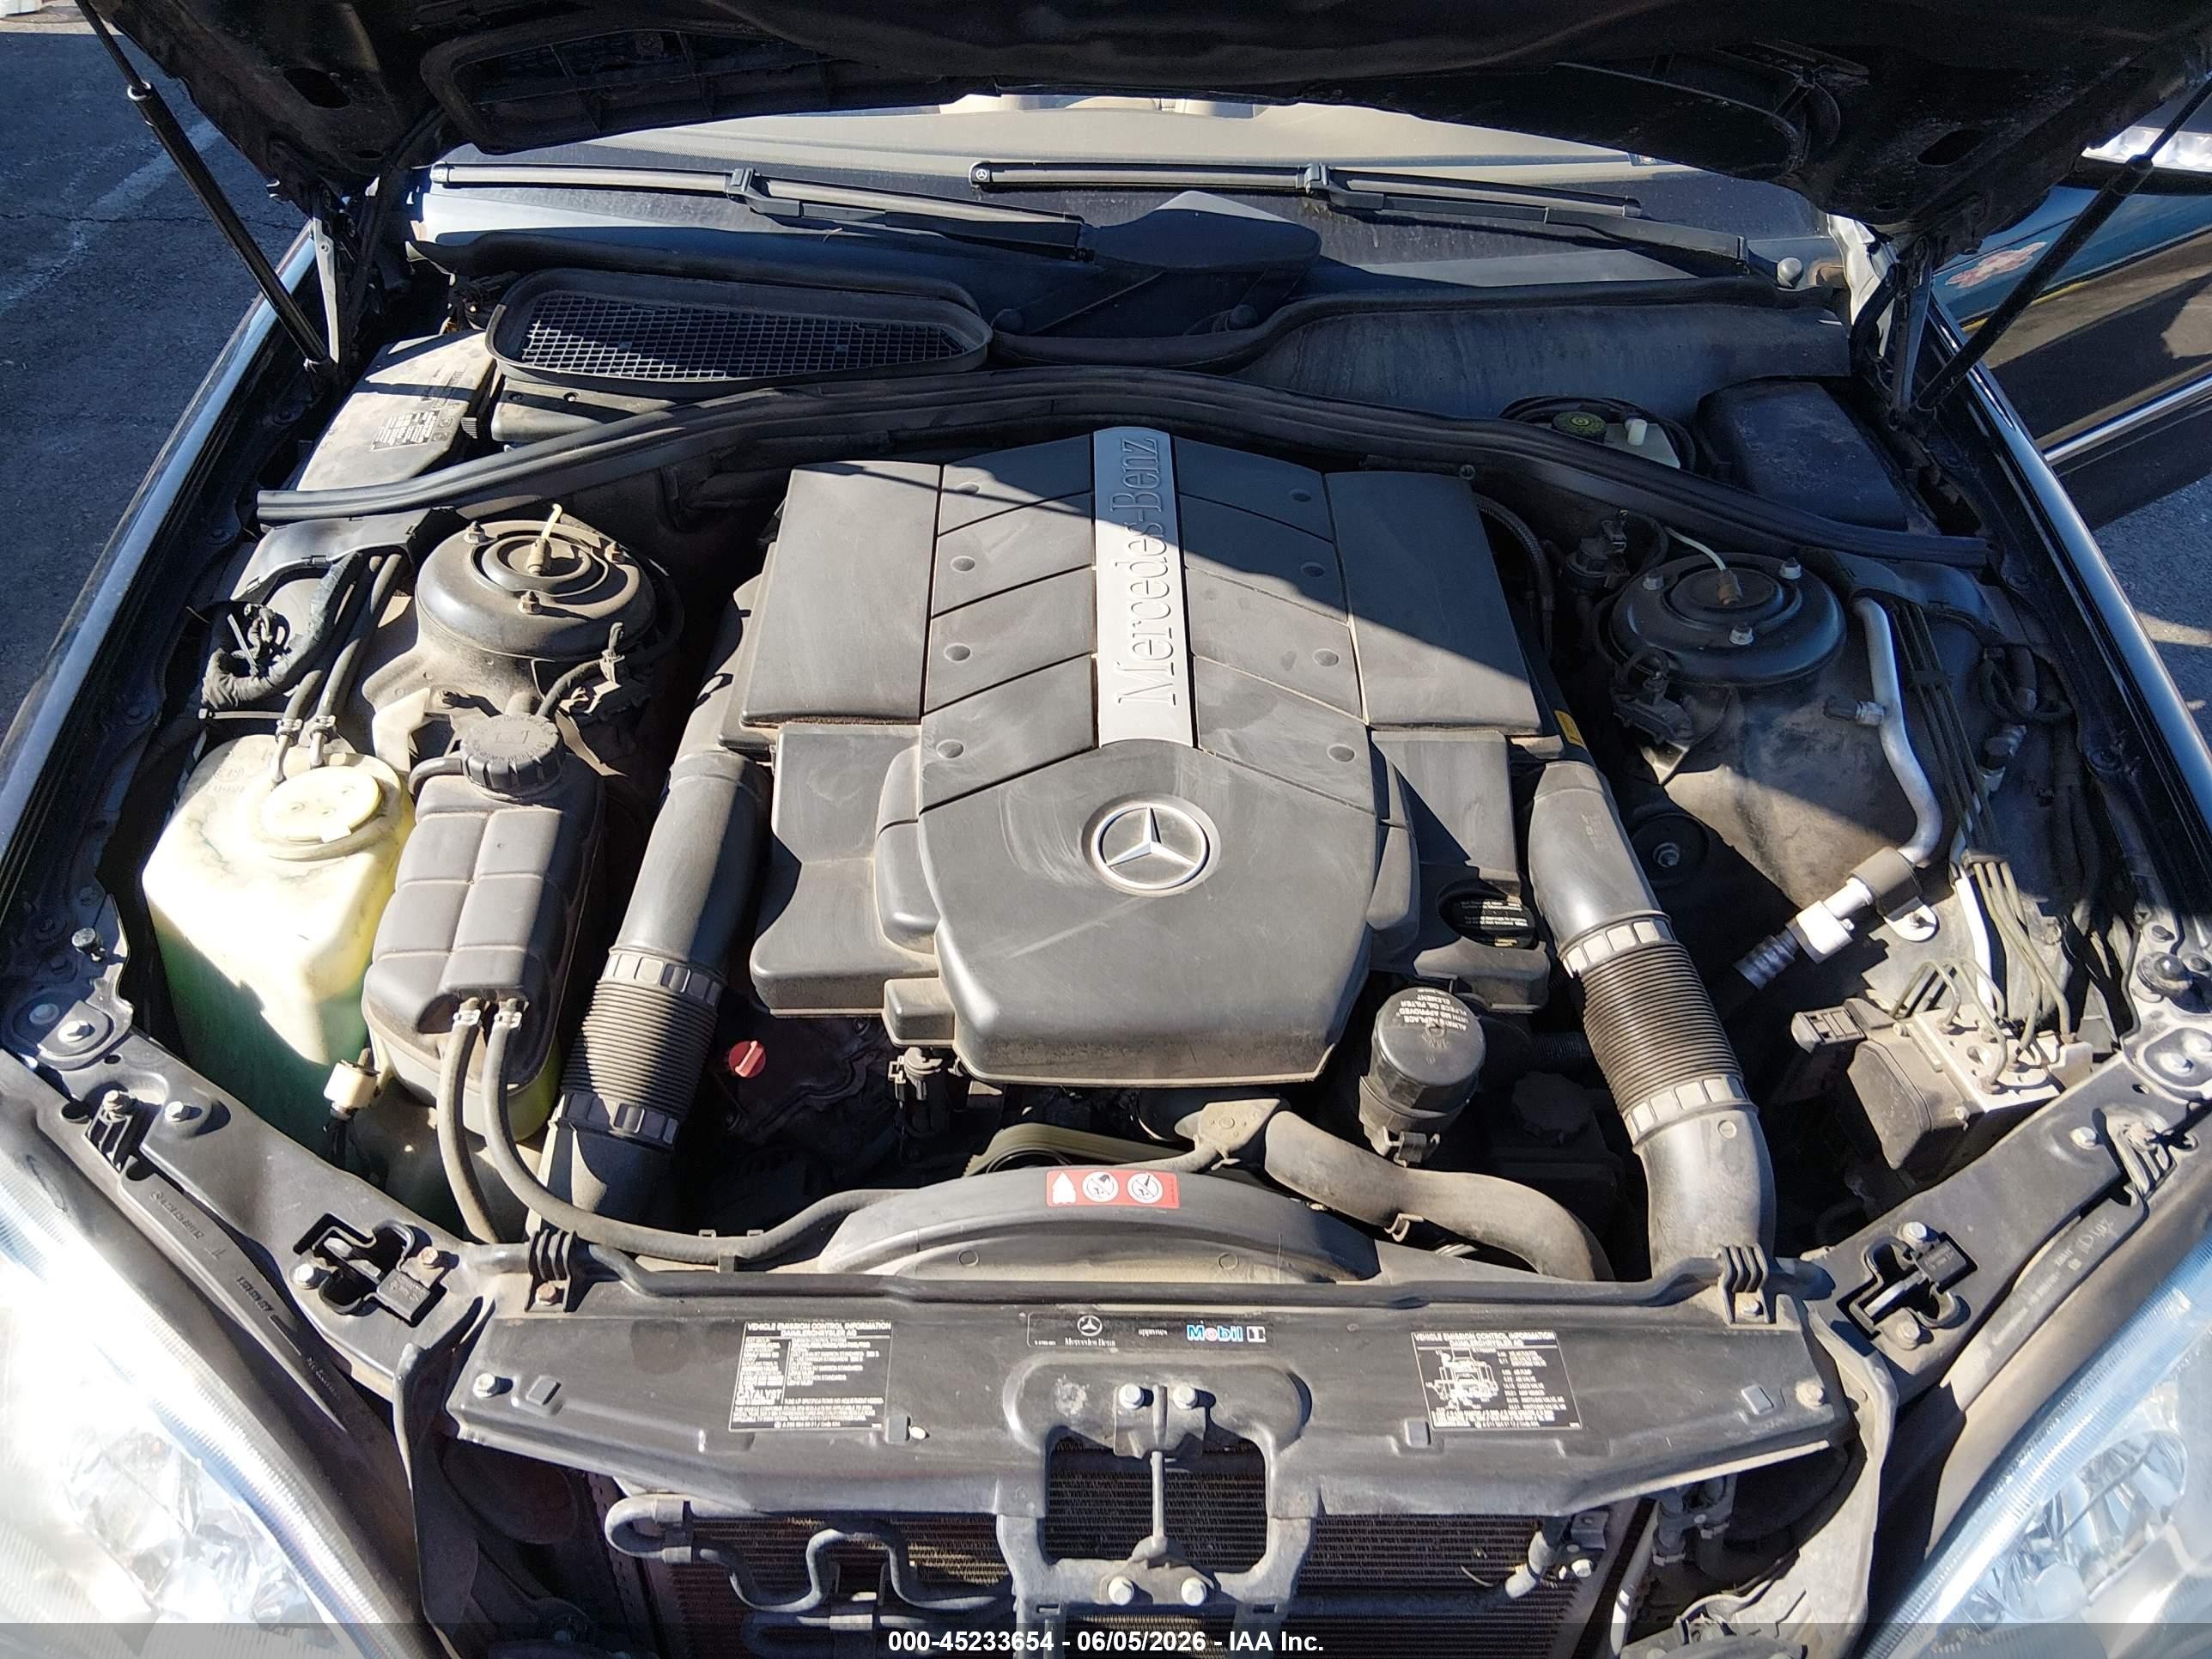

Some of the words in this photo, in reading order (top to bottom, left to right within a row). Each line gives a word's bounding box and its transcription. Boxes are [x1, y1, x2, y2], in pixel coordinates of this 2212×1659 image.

[1110, 436, 1176, 707] Mercedes-Benz
[1417, 994, 1450, 1005] ELEMENT
[811, 1322, 843, 1331] CONTROL
[1187, 1324, 1243, 1342] Mobil
[1414, 1332, 1443, 1341] VEHICLE
[1443, 1332, 1475, 1341] EMISSION
[1476, 1332, 1508, 1341] CONTROL
[1509, 1332, 1556, 1340] INFORMATION
[737, 1389, 781, 1400] CATALYST
